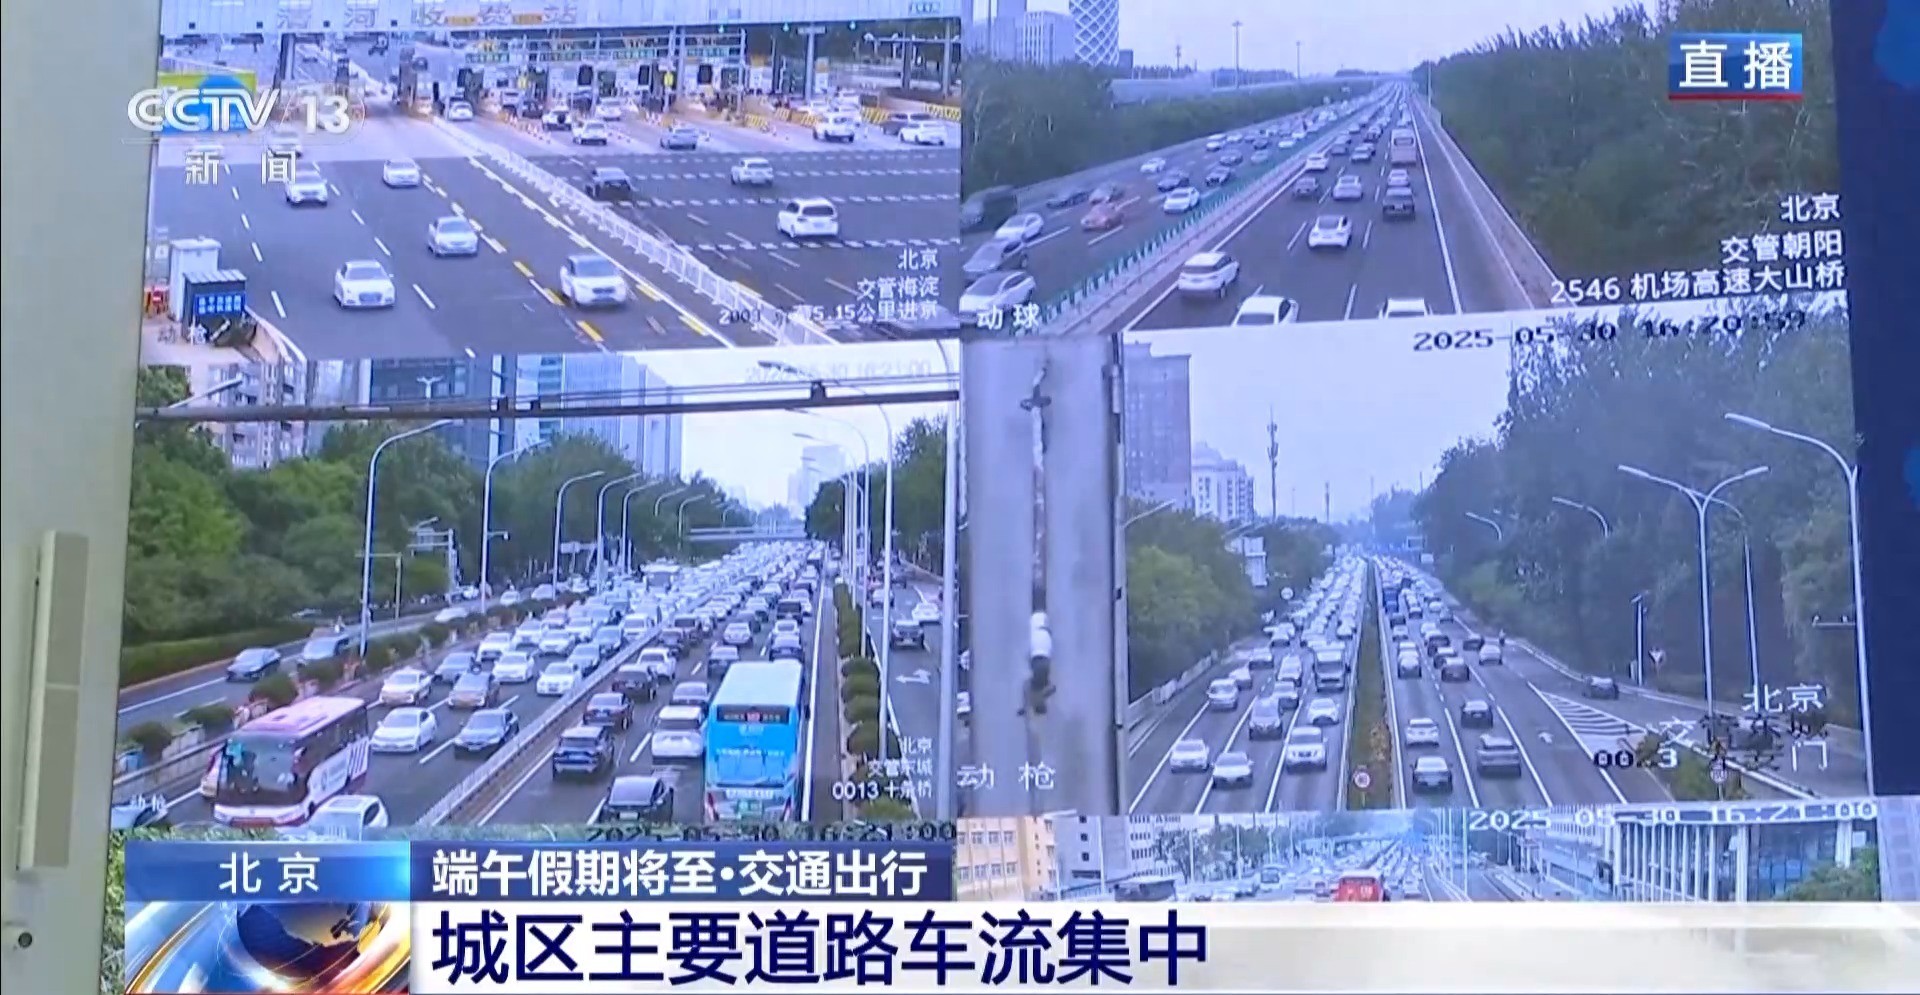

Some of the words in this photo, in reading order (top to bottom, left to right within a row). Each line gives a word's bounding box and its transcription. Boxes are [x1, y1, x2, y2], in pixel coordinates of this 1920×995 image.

[1781, 192, 1840, 222] 北京
[898, 247, 938, 271] 北京
[1721, 230, 1842, 264] 交管朝阳
[856, 275, 940, 301] 交管海淀
[1551, 276, 1621, 303] 2546
[1630, 260, 1845, 301] 机场高速大山桥
[977, 302, 1042, 331] 动球
[1743, 682, 1824, 713] 北京
[832, 781, 880, 800] 0013
[957, 762, 1057, 792] 动枪
[1711, 802, 1878, 824] 16:21:00
